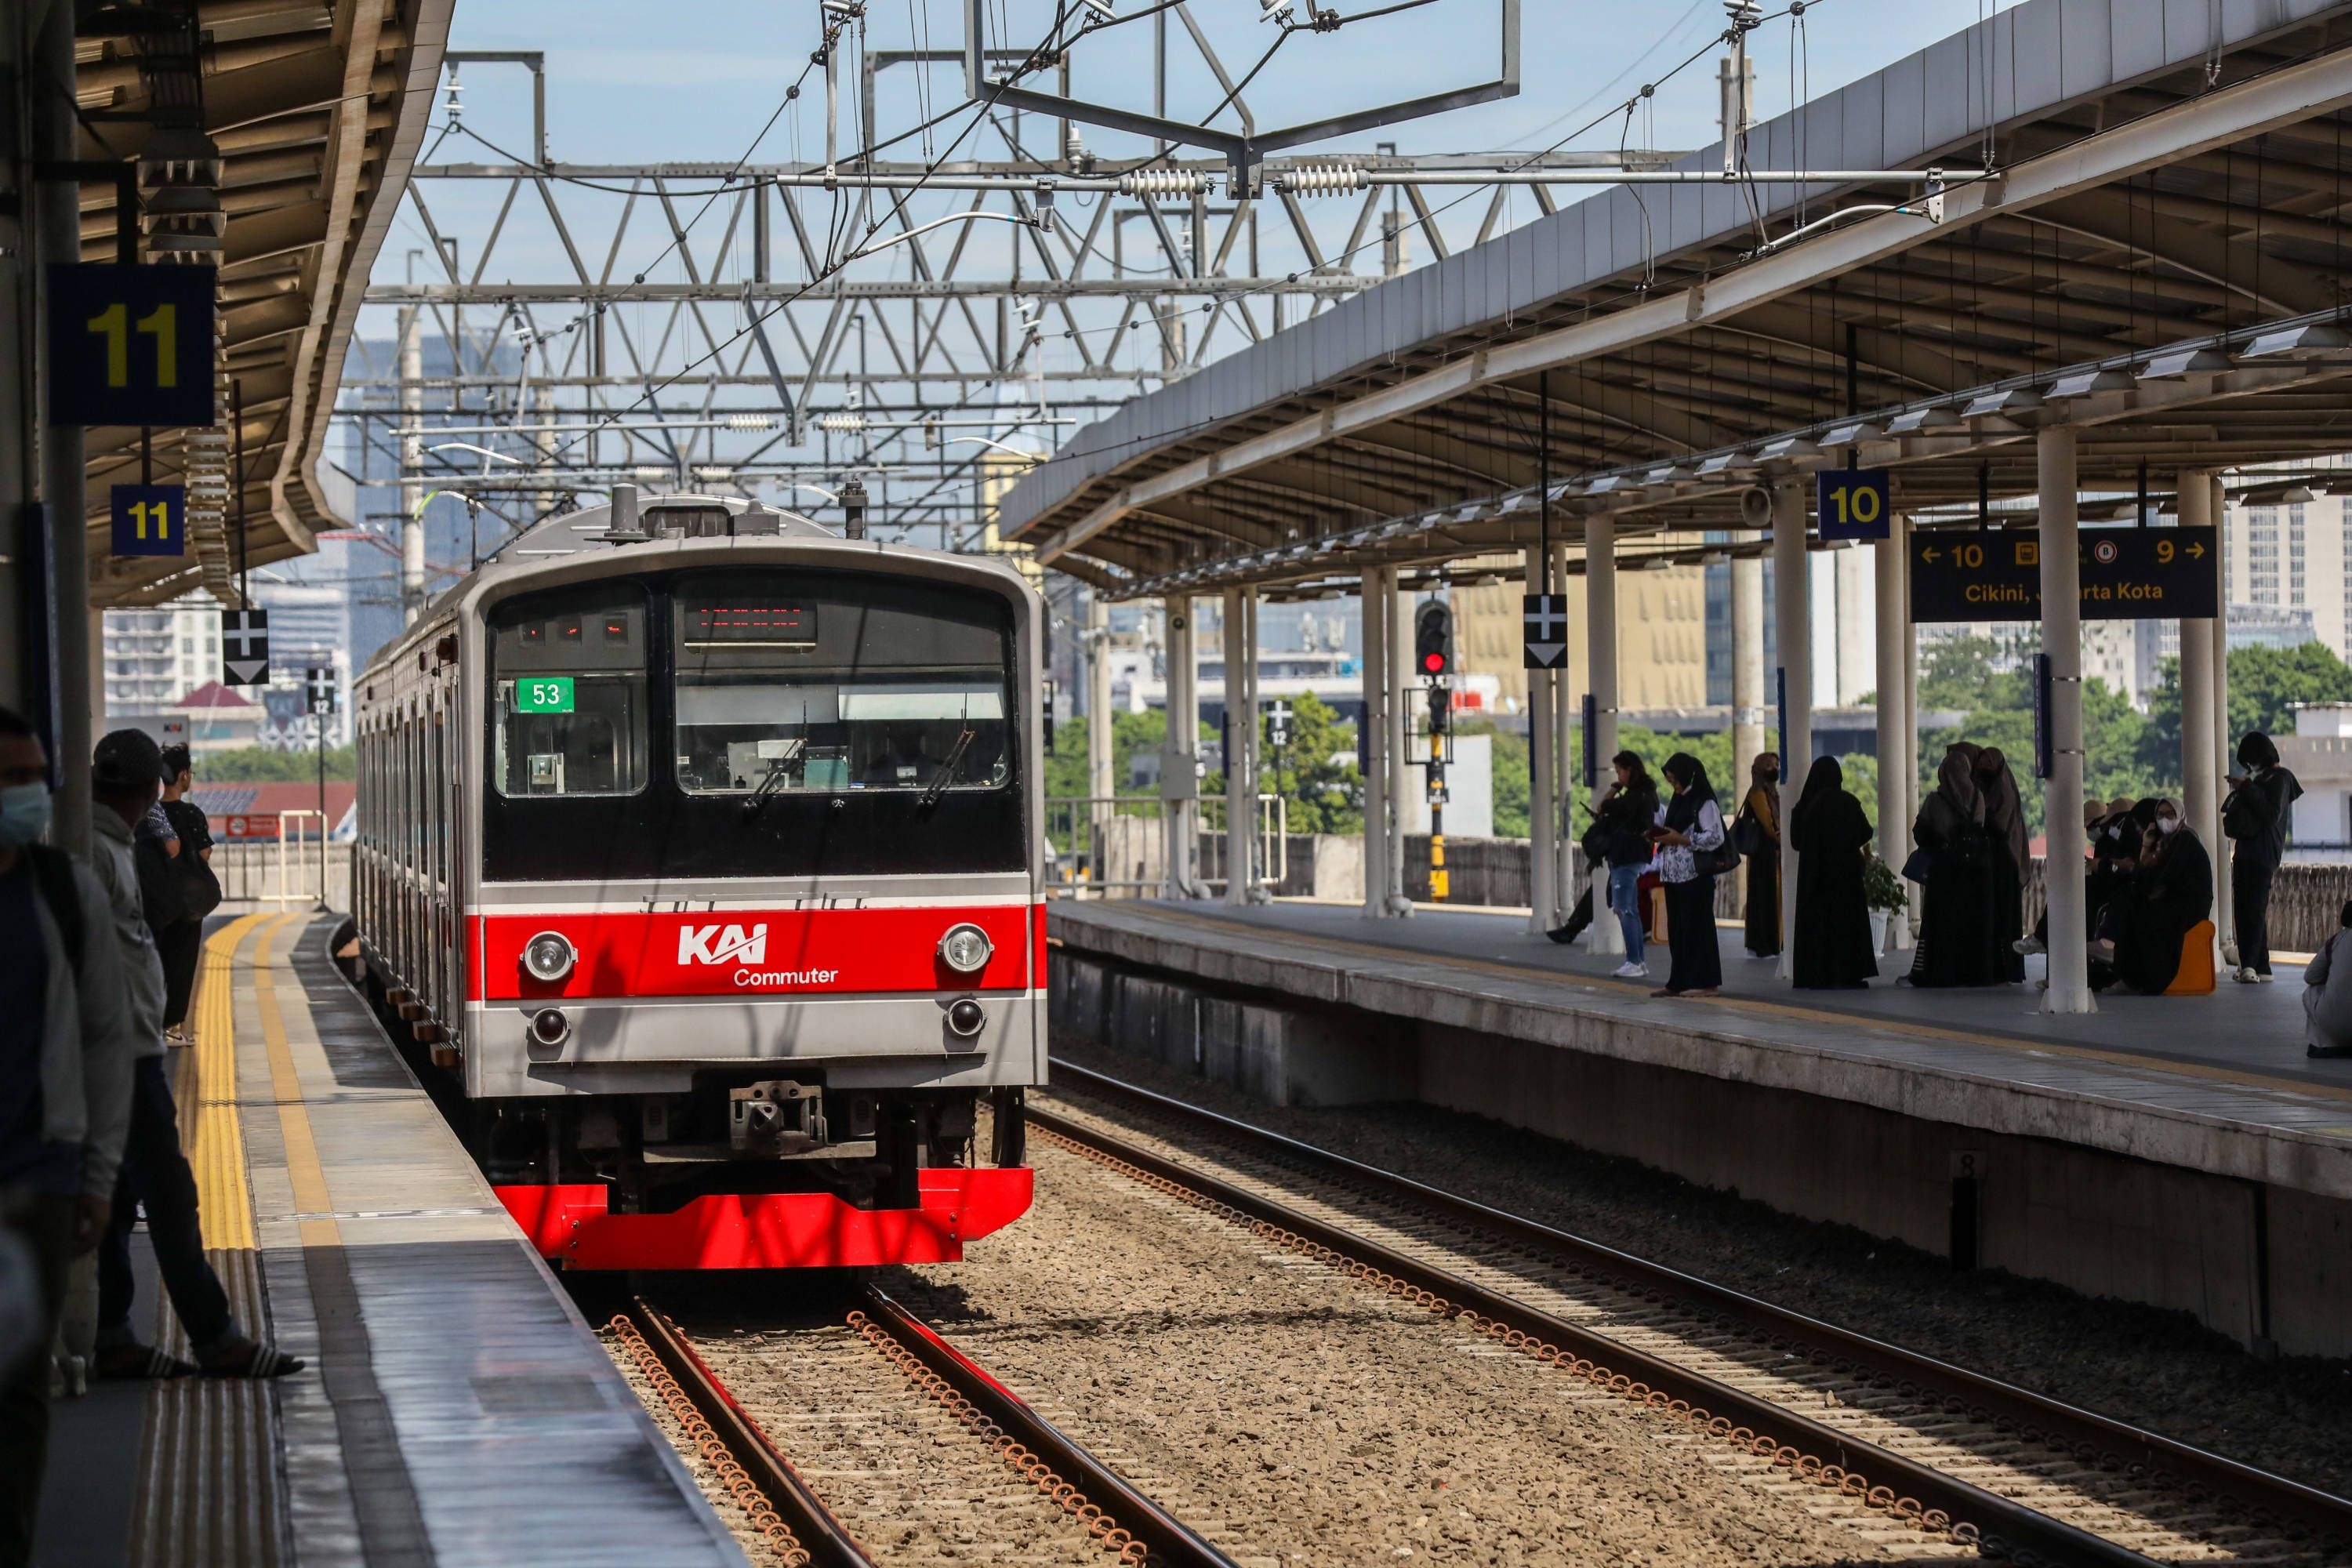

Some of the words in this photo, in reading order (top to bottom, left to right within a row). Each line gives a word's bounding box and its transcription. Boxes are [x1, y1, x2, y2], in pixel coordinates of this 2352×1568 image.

[87, 303, 176, 387] 11
[1829, 486, 1880, 524] 10
[128, 501, 168, 539] 11
[1951, 545, 1983, 568] 10
[2157, 539, 2174, 564] 9
[1965, 583, 2031, 604] Cikini,
[2117, 582, 2163, 601] Kota
[533, 684, 560, 705] 53
[314, 699, 329, 714] 12
[1271, 730, 1287, 746] 12
[677, 923, 768, 965] KAI
[734, 967, 839, 986] Commuter
